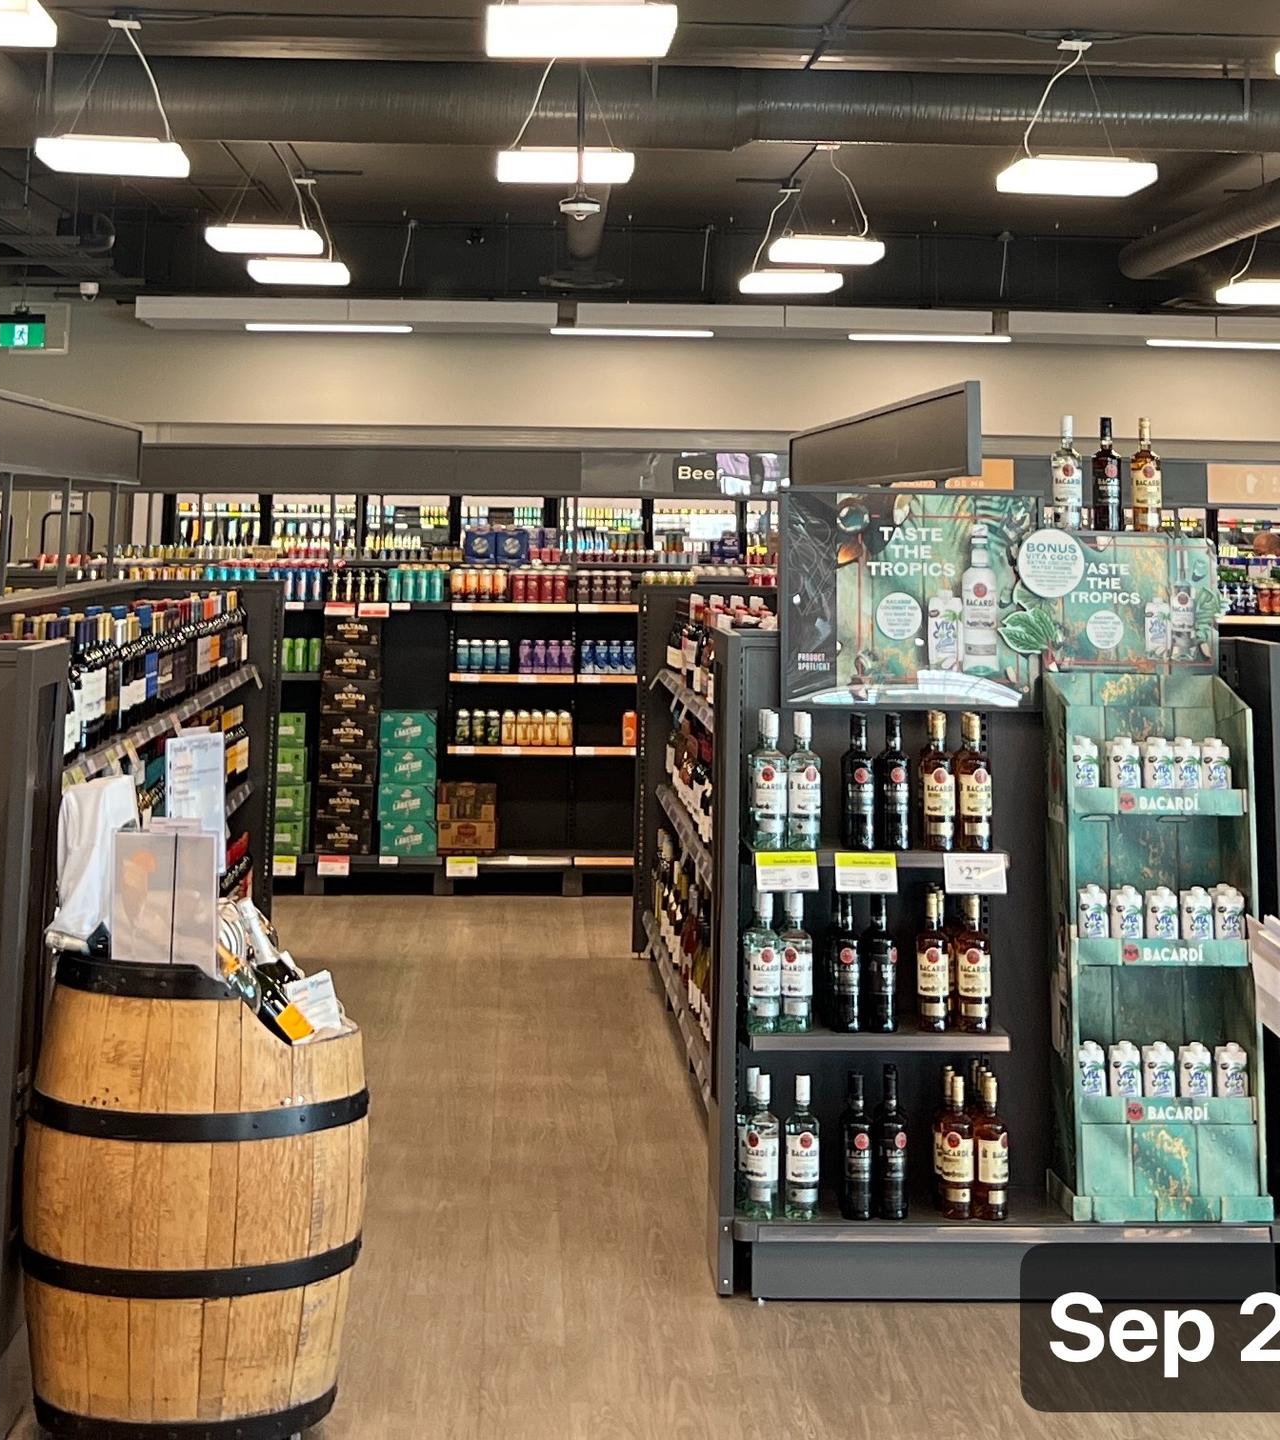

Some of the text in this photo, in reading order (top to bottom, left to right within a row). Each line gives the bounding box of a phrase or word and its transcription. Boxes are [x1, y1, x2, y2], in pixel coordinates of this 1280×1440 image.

[677, 465, 723, 480] Beer
[879, 526, 943, 542] TASTE
[890, 544, 932, 559] THE
[1026, 543, 1076, 553] BONUS
[867, 561, 956, 577] TROPICS
[1085, 563, 1129, 575] ASTE
[1086, 577, 1120, 589] THE
[1070, 592, 1141, 605] TROPICS
[797, 653, 826, 662] PRODUCT
[797, 662, 830, 671] SPOTLIGHT
